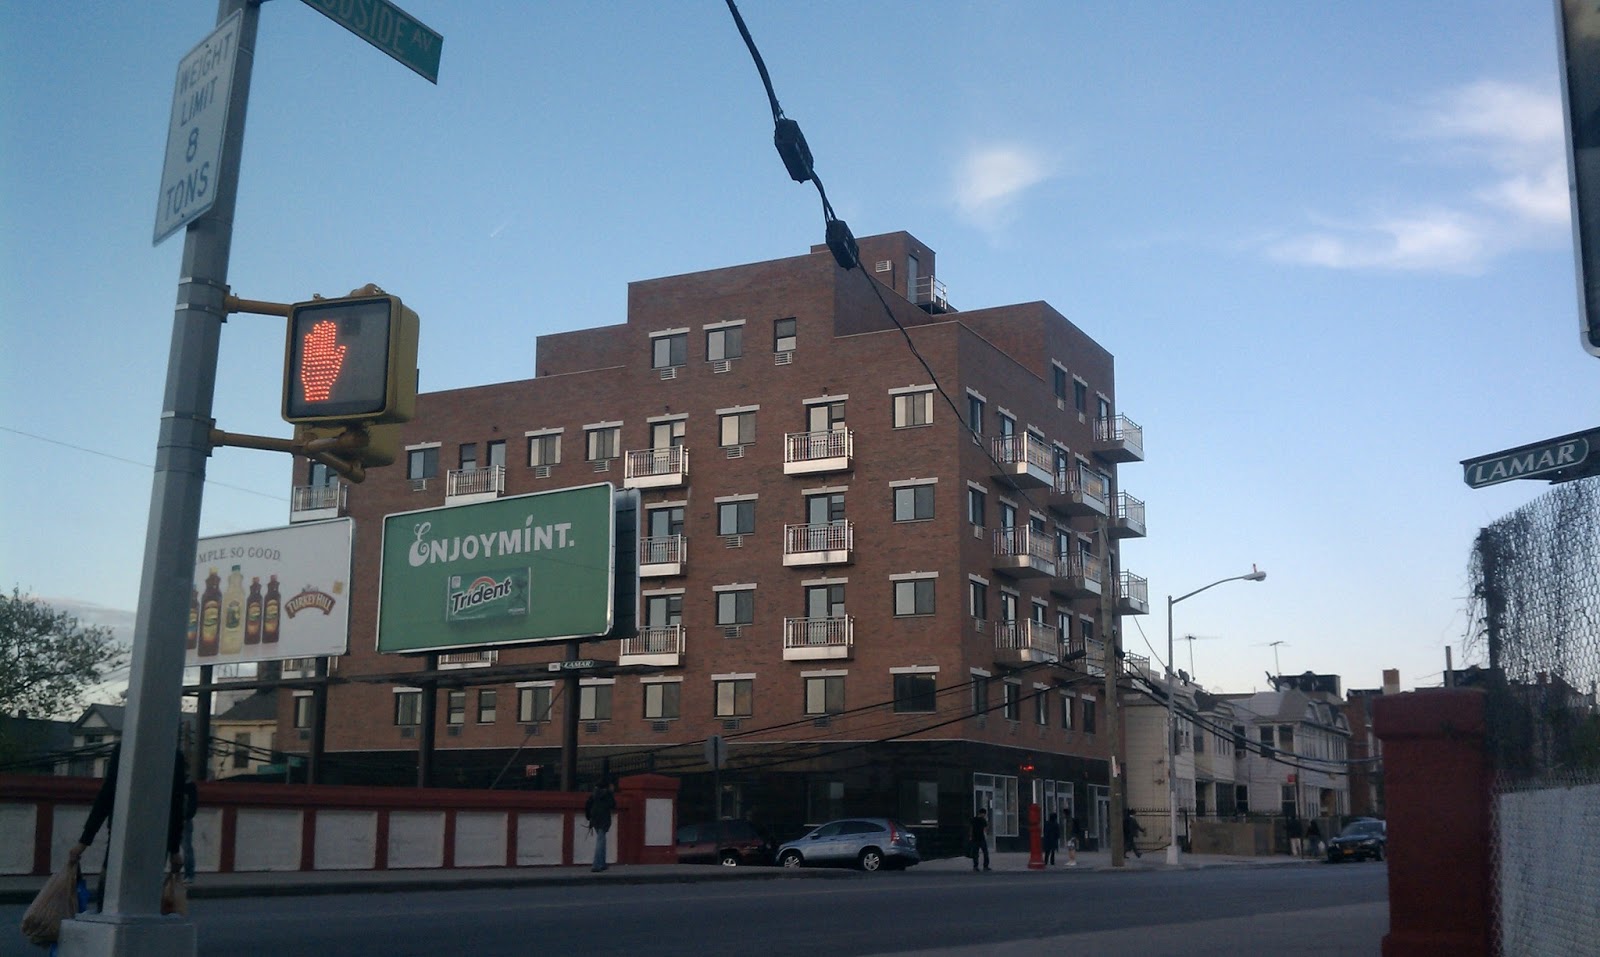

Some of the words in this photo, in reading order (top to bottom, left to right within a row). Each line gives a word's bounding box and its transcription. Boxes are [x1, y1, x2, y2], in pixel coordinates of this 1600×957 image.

[322, 0, 405, 53] DSIDE
[411, 27, 436, 52] AV
[180, 31, 233, 96] WEIGHT
[181, 75, 218, 127] LIMIT
[186, 127, 199, 162] 8
[165, 161, 210, 220] TONS
[1474, 444, 1576, 484] LAMAR
[230, 546, 245, 558] SO
[451, 576, 512, 615] Trident
[564, 660, 592, 669] LAMAR
